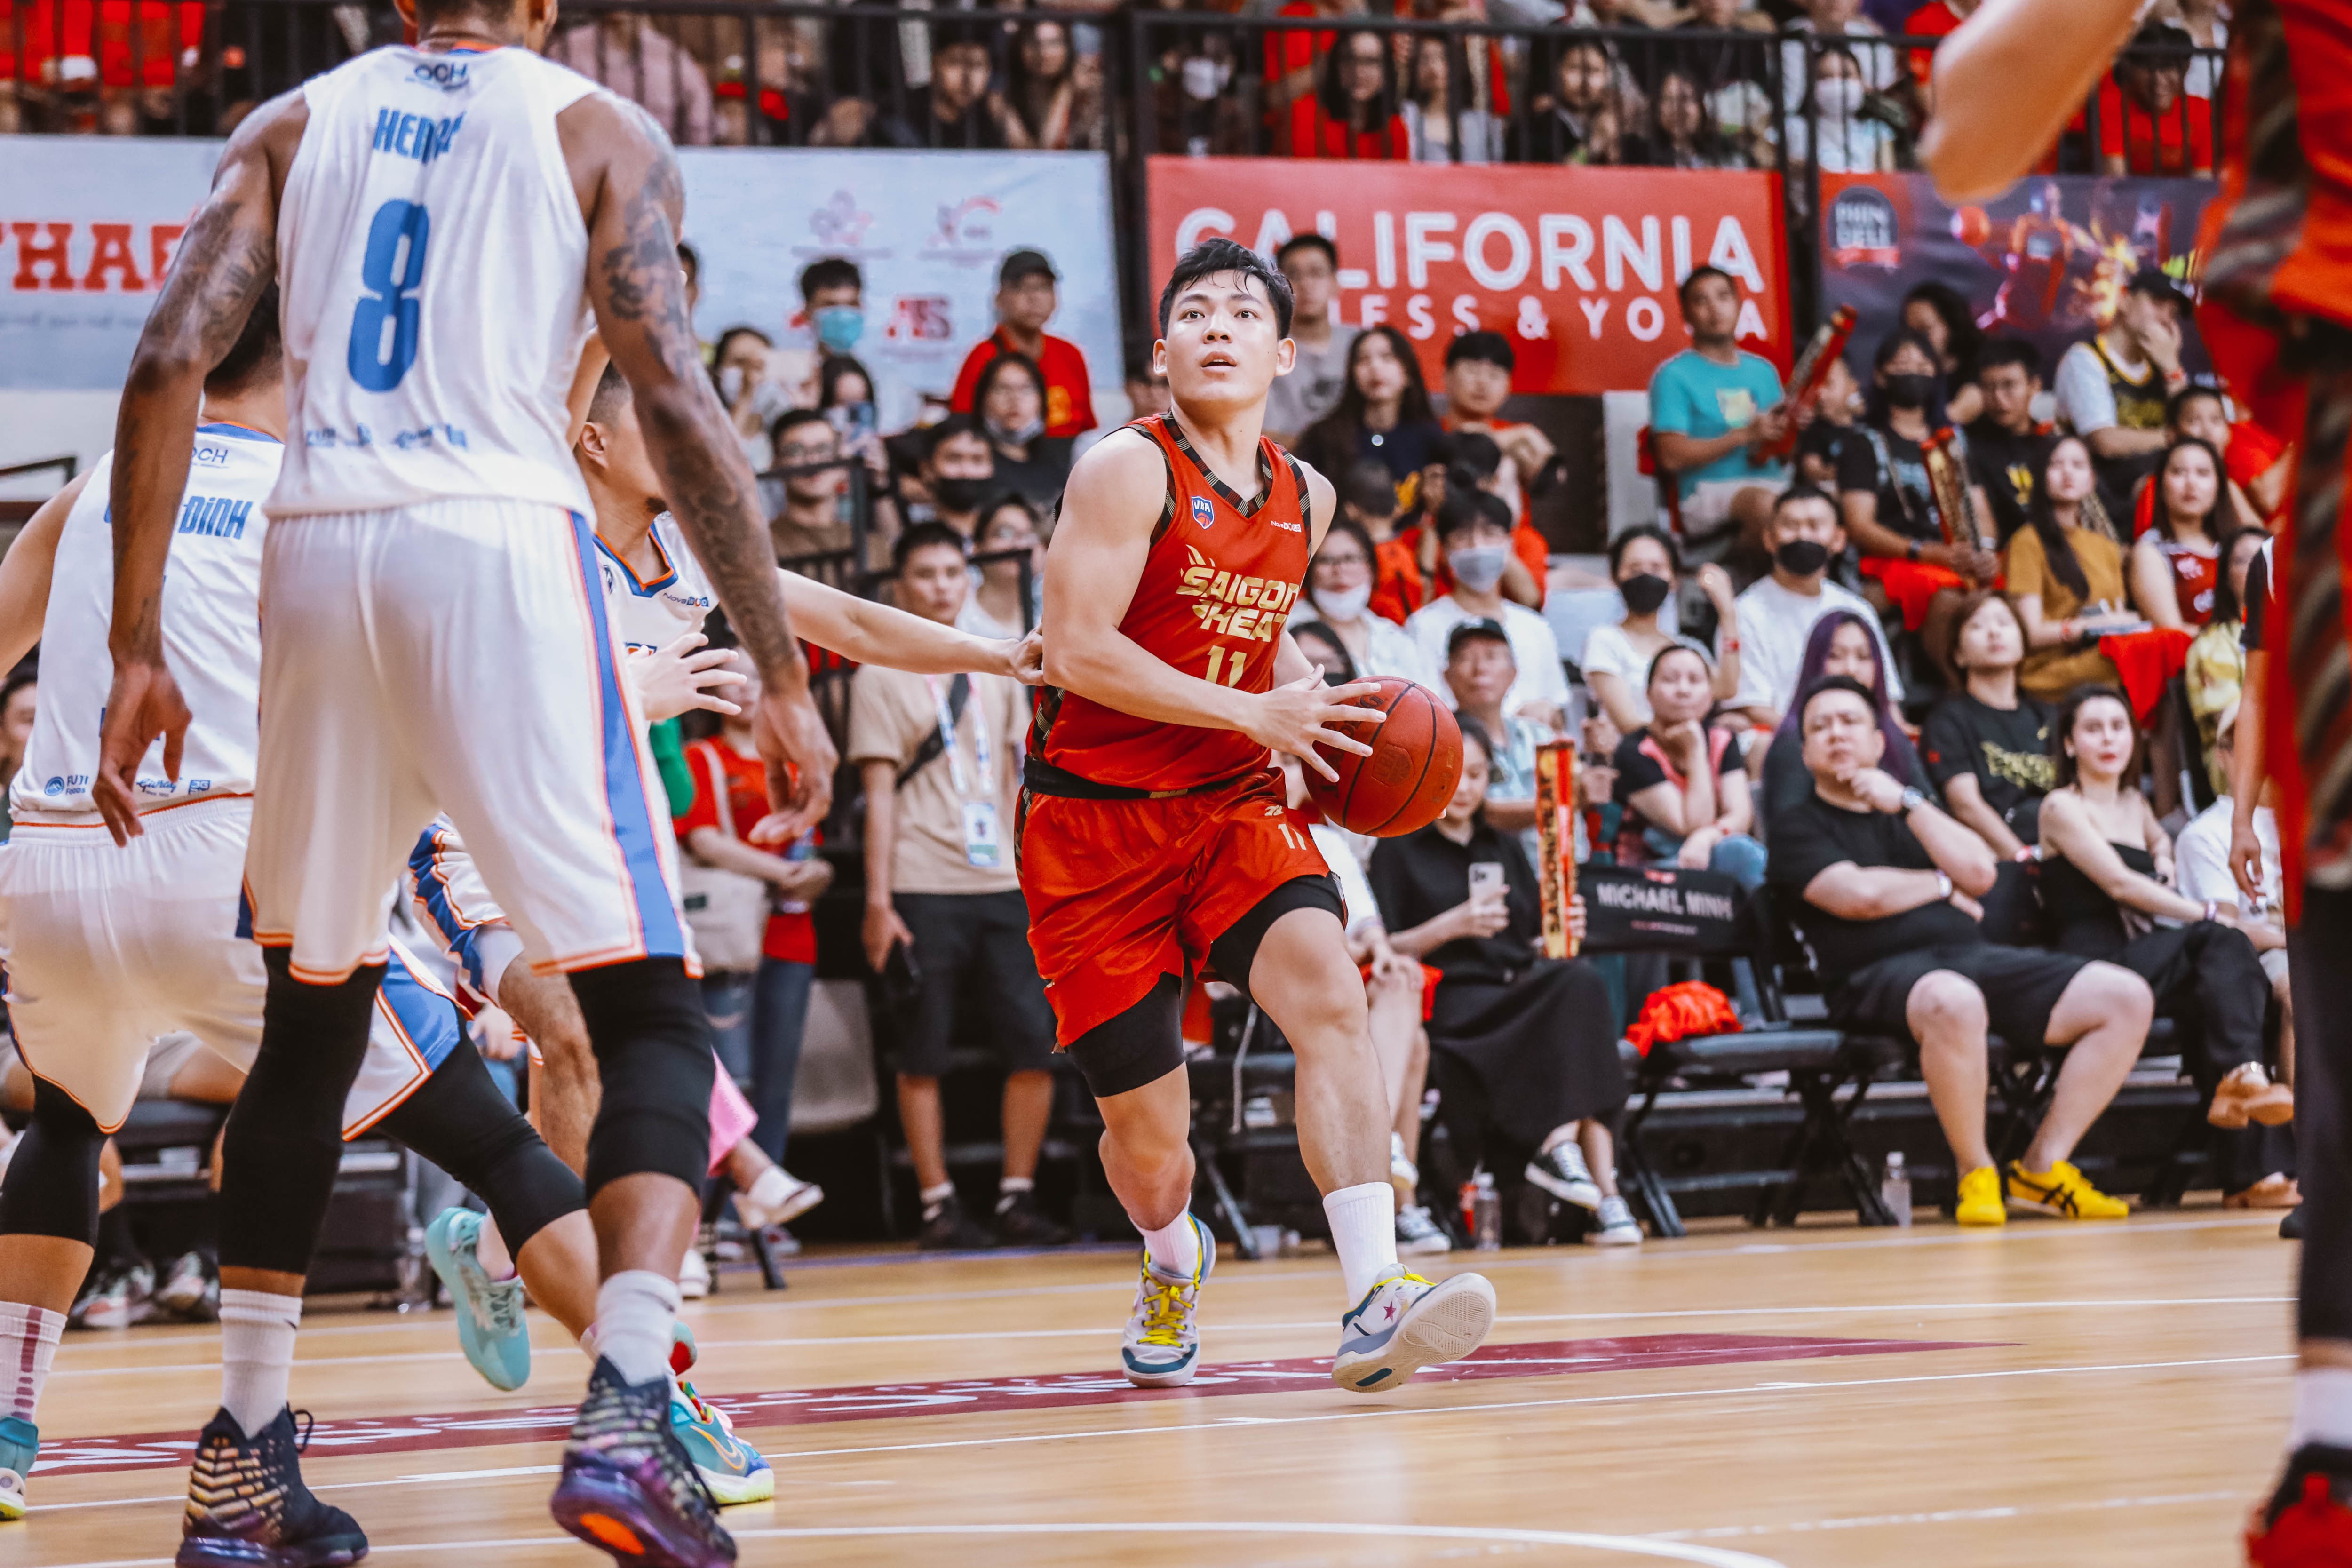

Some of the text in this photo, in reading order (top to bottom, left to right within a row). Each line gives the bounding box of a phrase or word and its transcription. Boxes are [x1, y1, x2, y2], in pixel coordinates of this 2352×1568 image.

[347, 198, 430, 393] 8
[1517, 294, 1549, 340] &
[1579, 296, 1767, 341] YOA
[1194, 501, 1211, 512] VBA
[1176, 566, 1299, 613] SAIGON
[1192, 599, 1288, 643] HEAT
[1205, 645, 1247, 688] 11
[1596, 883, 1734, 922] MICHAEL MINH
